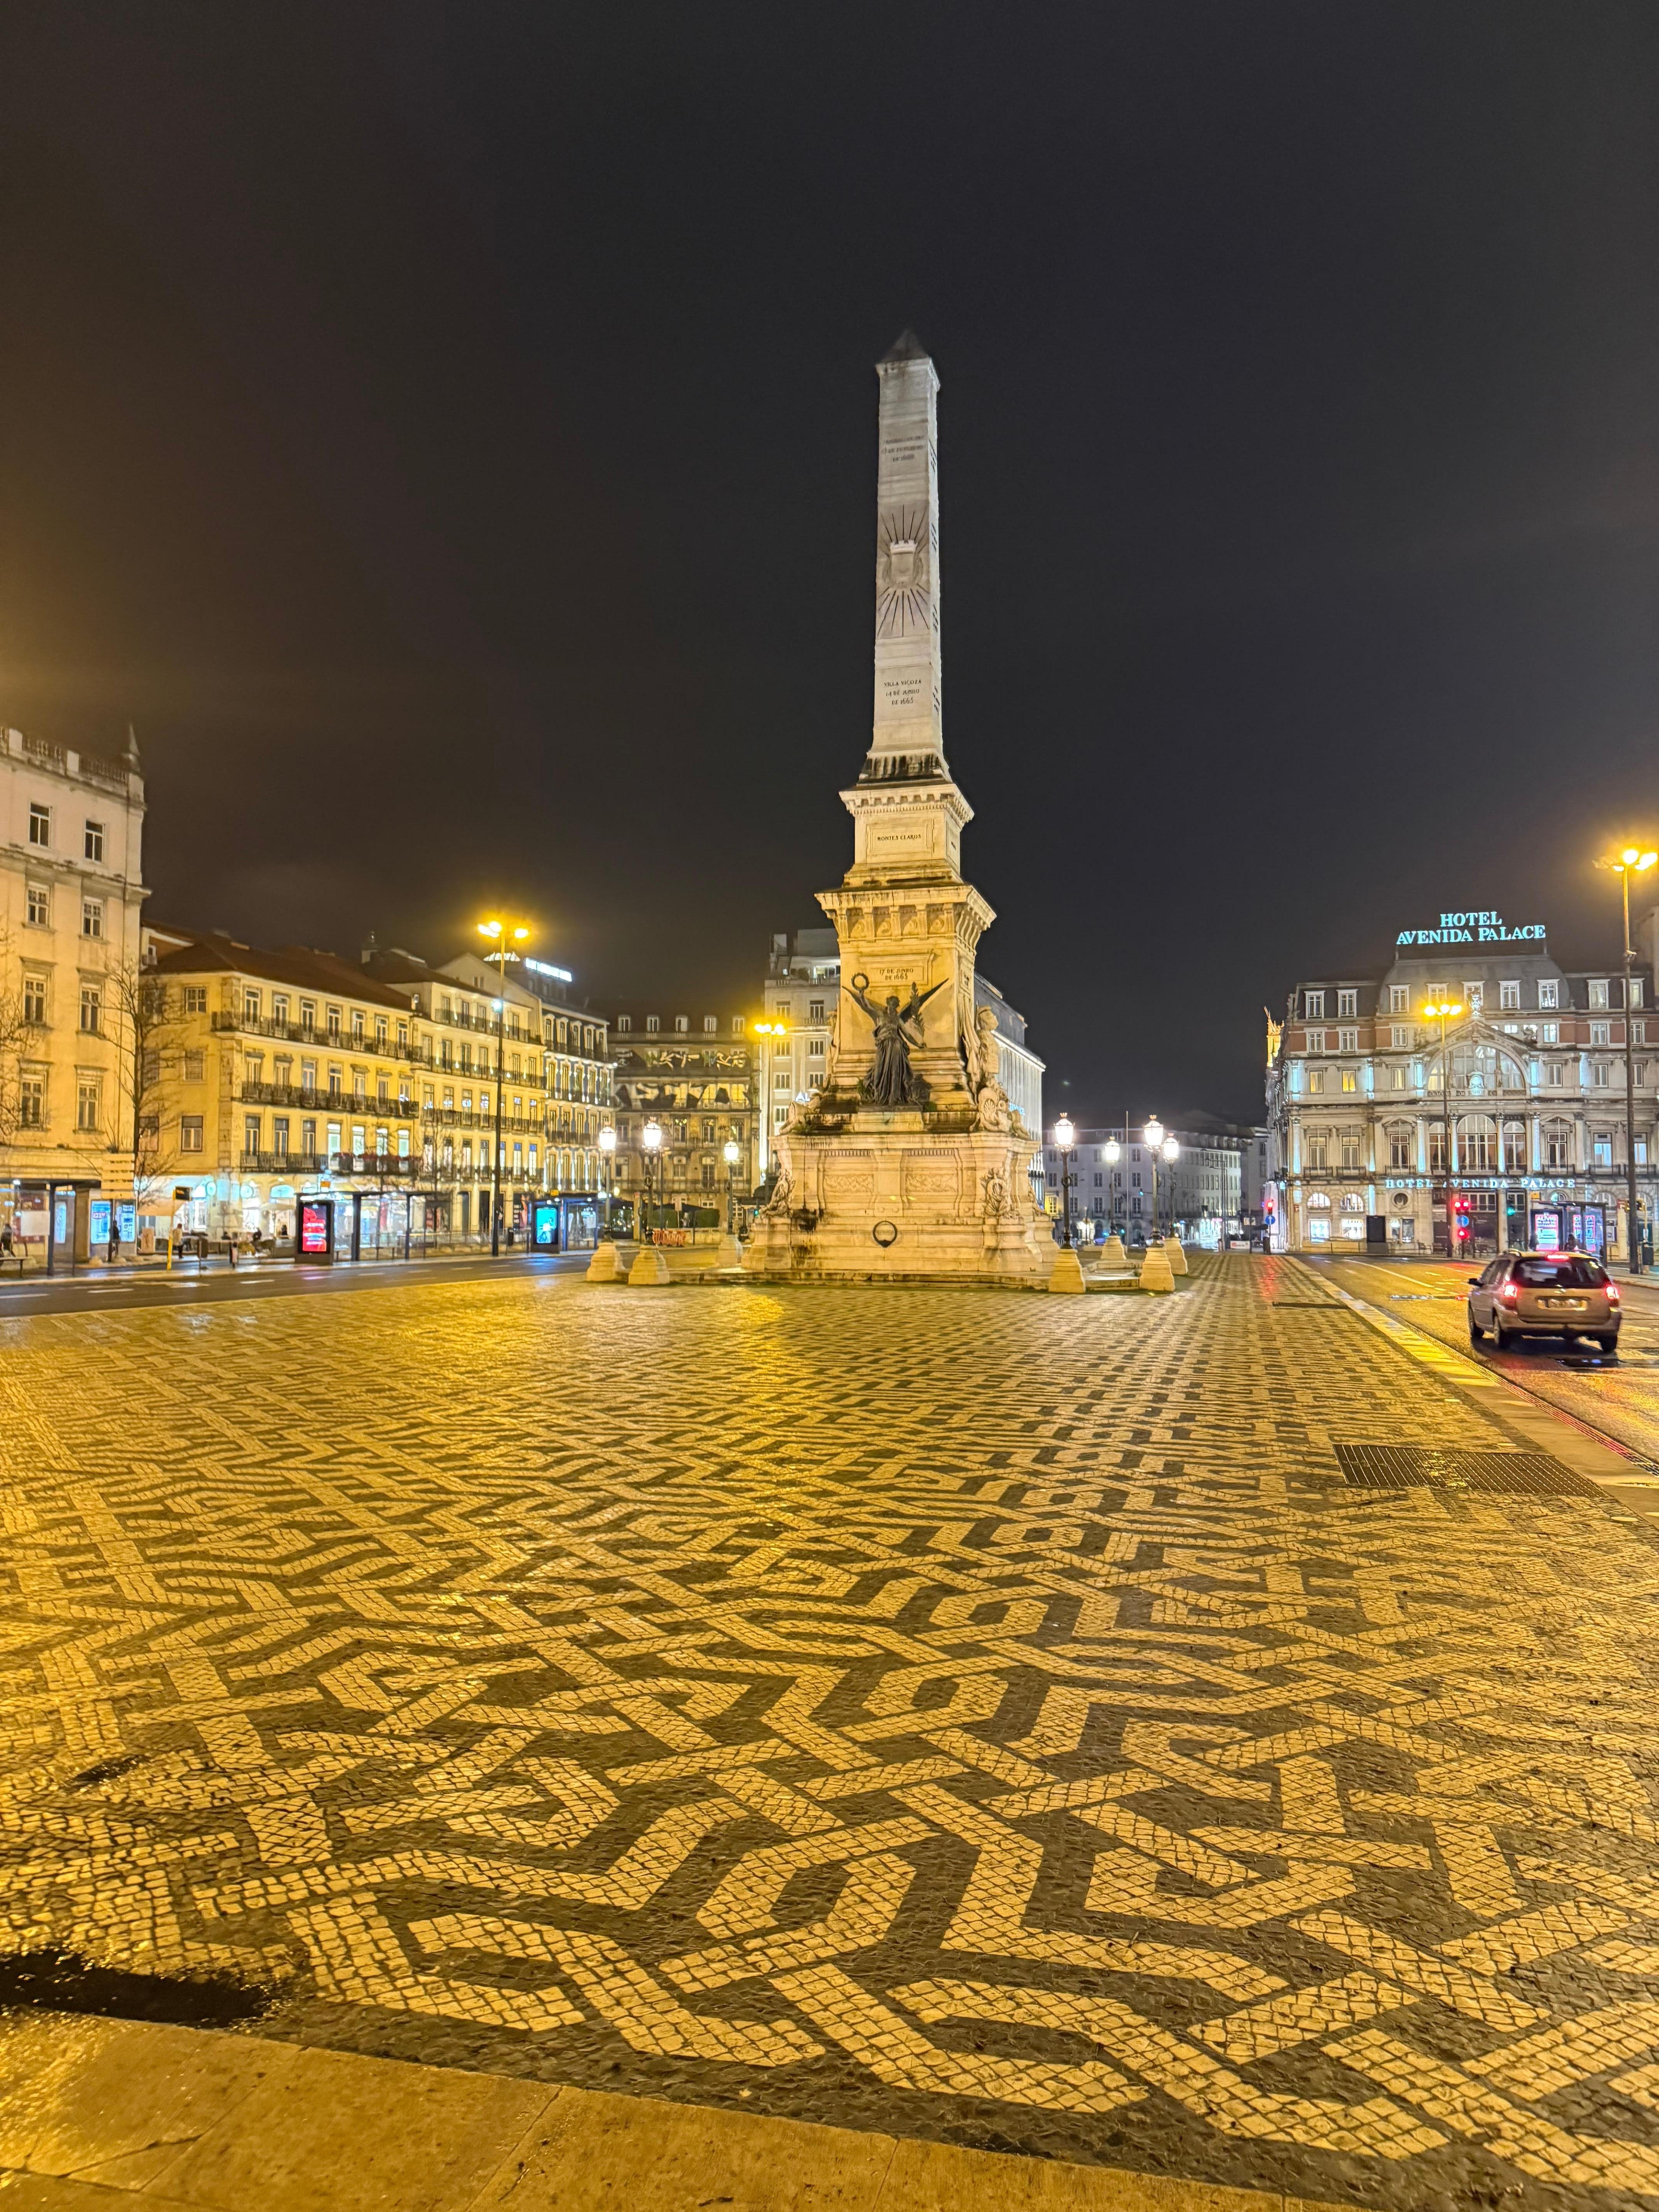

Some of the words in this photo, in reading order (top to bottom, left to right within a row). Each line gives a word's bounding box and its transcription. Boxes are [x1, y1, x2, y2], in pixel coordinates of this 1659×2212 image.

[1440, 911, 1502, 927] HOTEL
[1396, 929, 1474, 945] AVENIDA
[1478, 925, 1546, 941] PALACE
[1385, 1179, 1433, 1188] HOTEL
[1521, 1179, 1576, 1188] PALACE
